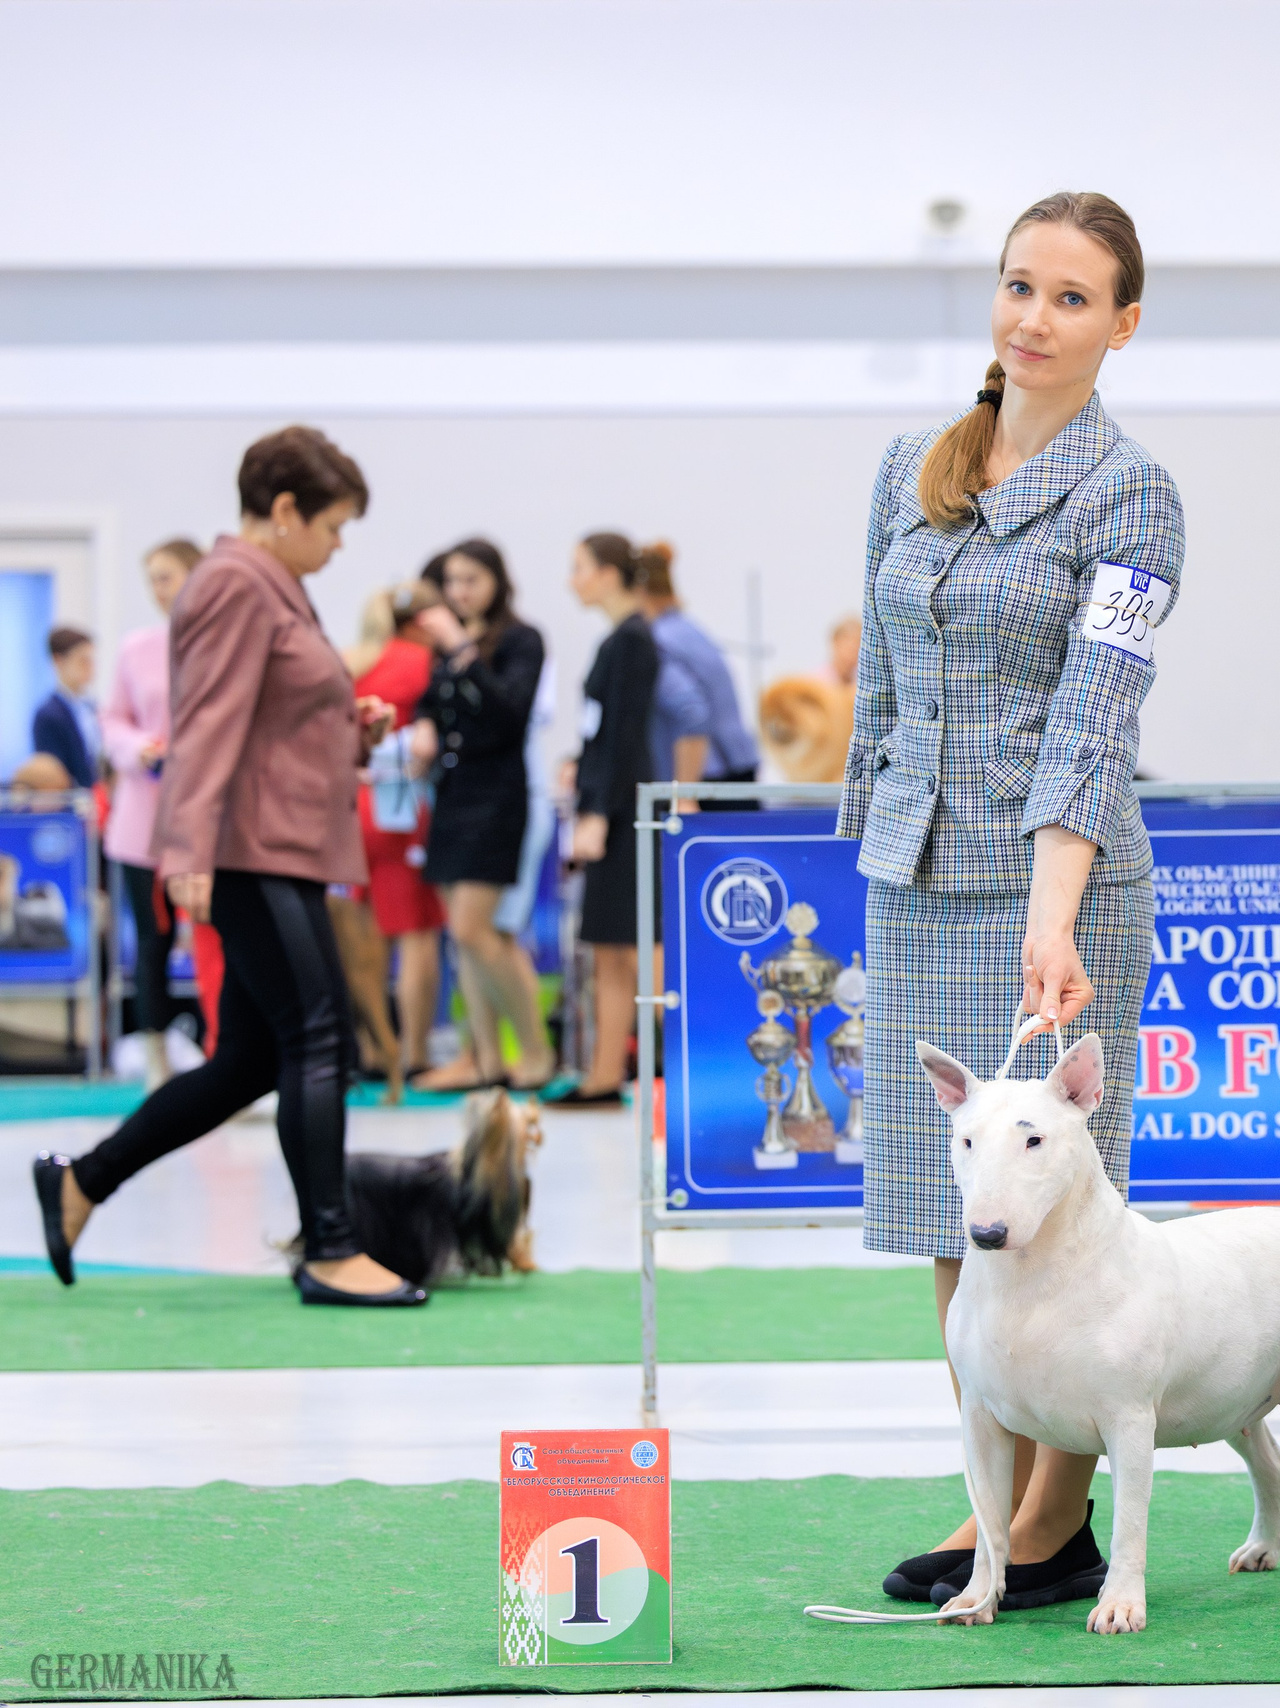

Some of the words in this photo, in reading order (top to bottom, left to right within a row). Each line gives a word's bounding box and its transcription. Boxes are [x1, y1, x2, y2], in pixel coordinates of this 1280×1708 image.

[1134, 575, 1148, 590] VIC
[1092, 591, 1149, 641] 393
[1152, 882, 1234, 899] ЧЕСКОЕ
[1146, 971, 1186, 1010] А
[1190, 1110, 1268, 1141] DOG
[542, 1447, 563, 1455] Союз
[564, 1447, 624, 1455] общественных
[557, 1456, 609, 1465] объединений
[503, 1477, 575, 1486] "БЕЛОРУССКОЕ
[577, 1476, 665, 1485] КИНОЛОГИЧЕСКОЕ
[548, 1487, 620, 1497] ОБЪЕДИНЕНИЕ"
[560, 1536, 611, 1626] 1
